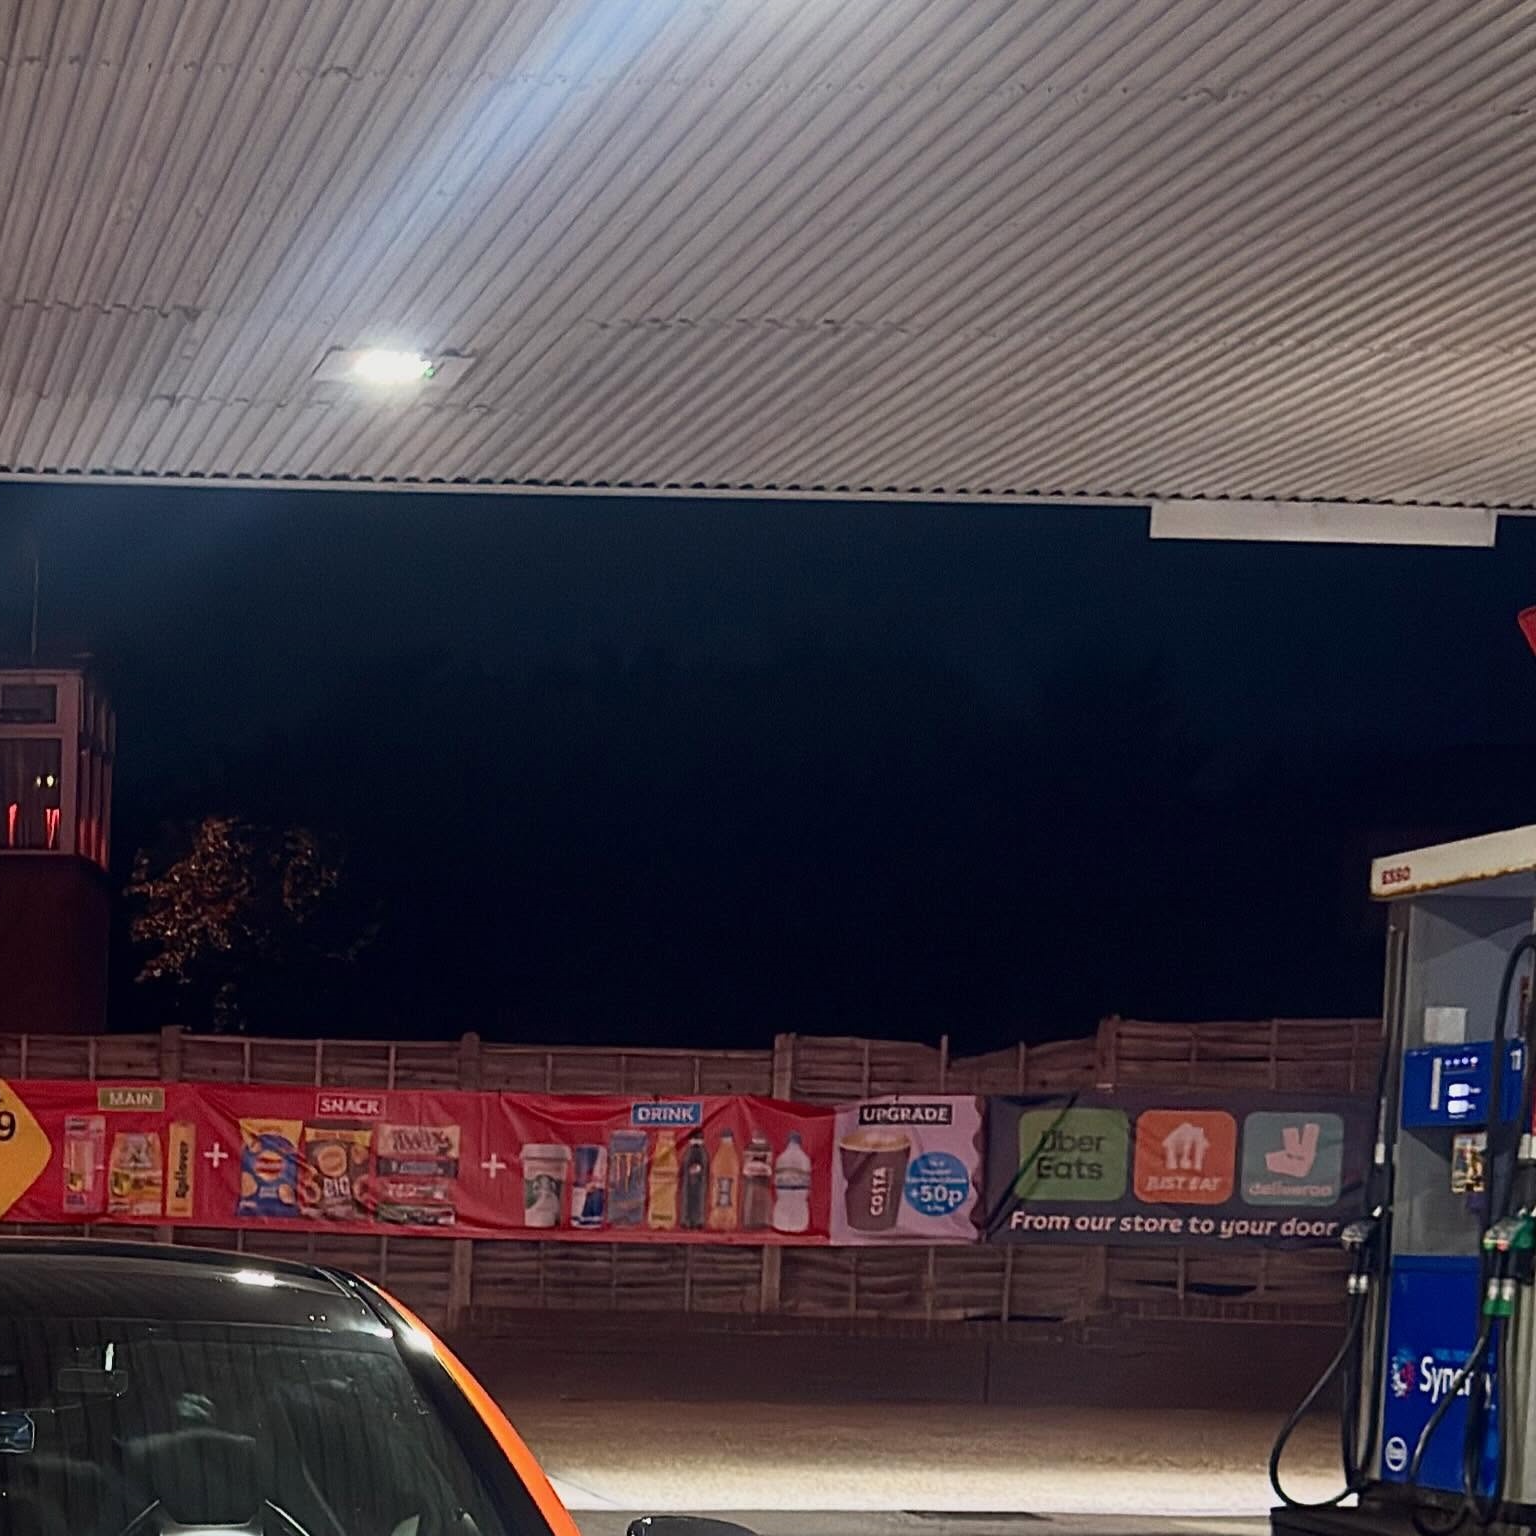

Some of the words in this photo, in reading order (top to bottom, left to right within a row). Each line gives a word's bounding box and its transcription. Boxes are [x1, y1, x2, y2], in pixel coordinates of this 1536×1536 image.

[1382, 866, 1410, 885] ESSO
[109, 1091, 154, 1105] MAIN
[319, 1099, 381, 1114] SNACK
[637, 1106, 694, 1122] DRINK
[863, 1107, 949, 1122] UPGRADE
[1039, 1130, 1107, 1154] Uber
[1036, 1156, 1104, 1180] Eats
[870, 1167, 887, 1216] COSTA
[1010, 1211, 1069, 1231] From
[1075, 1217, 1116, 1231] our
[1119, 1216, 1182, 1233] store
[1188, 1216, 1215, 1233] to
[1219, 1219, 1277, 1239] your
[1280, 1218, 1339, 1237] door
